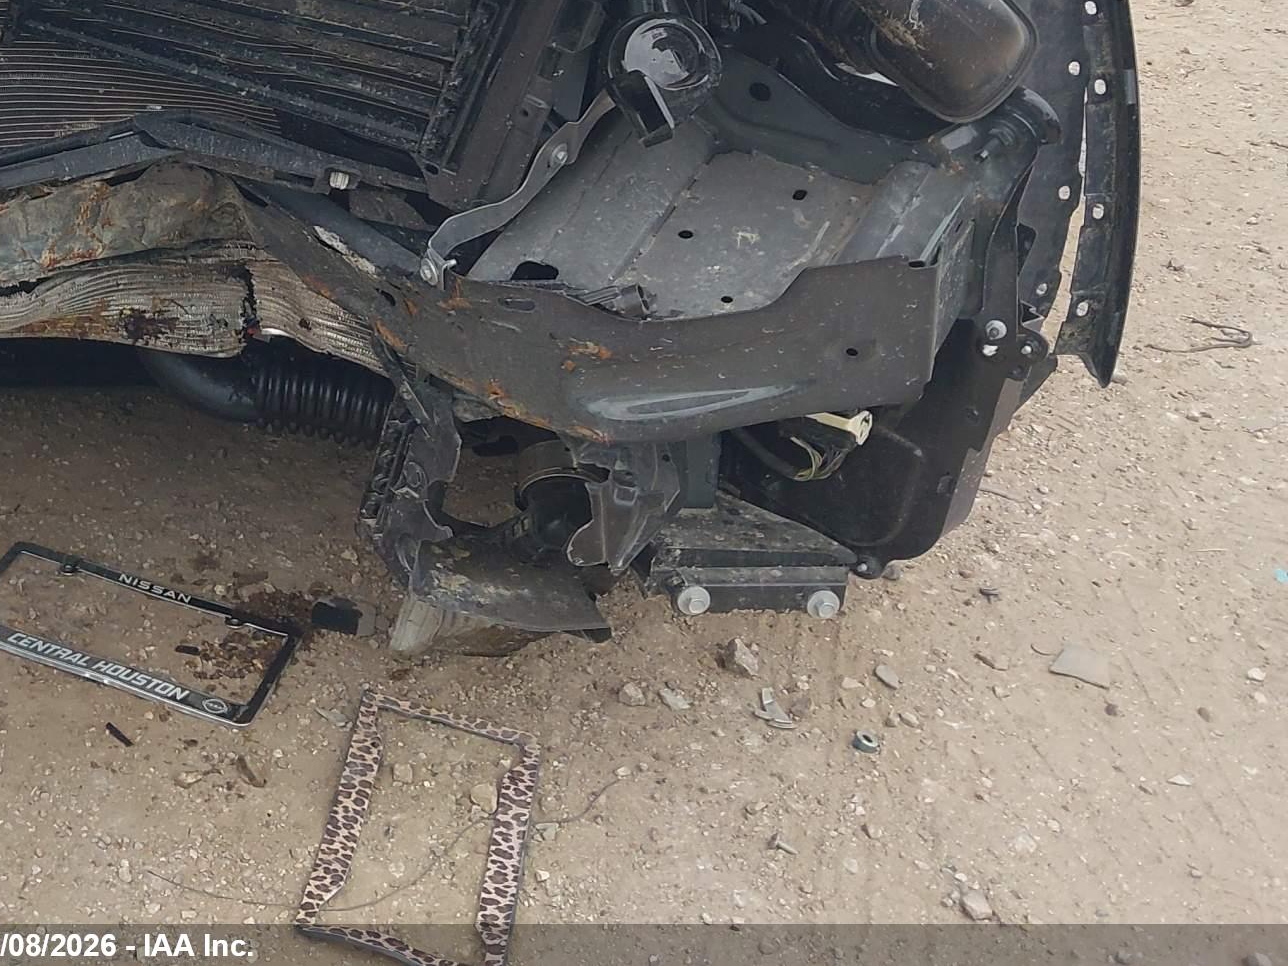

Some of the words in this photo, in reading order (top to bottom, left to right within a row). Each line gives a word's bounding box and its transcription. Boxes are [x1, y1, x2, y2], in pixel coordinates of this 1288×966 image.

[117, 573, 192, 604] NISSAN
[7, 632, 91, 666] CENTRAL
[92, 659, 190, 700] HOUSTON
